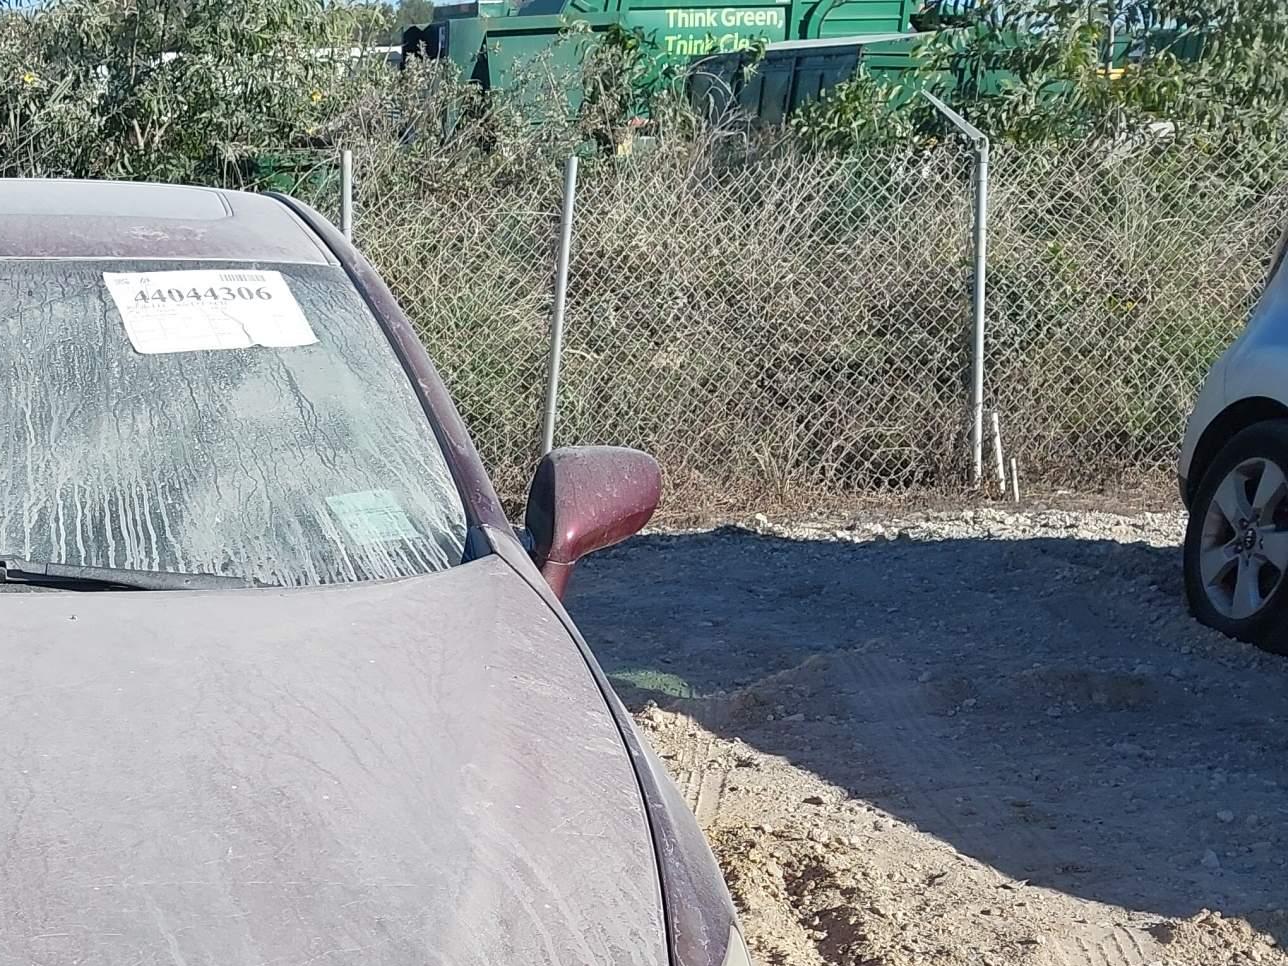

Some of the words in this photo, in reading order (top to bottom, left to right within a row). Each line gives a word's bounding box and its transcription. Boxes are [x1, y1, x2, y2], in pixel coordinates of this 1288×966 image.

[665, 9, 718, 28] Think
[721, 8, 784, 28] Green,
[134, 286, 273, 303] 44044306
